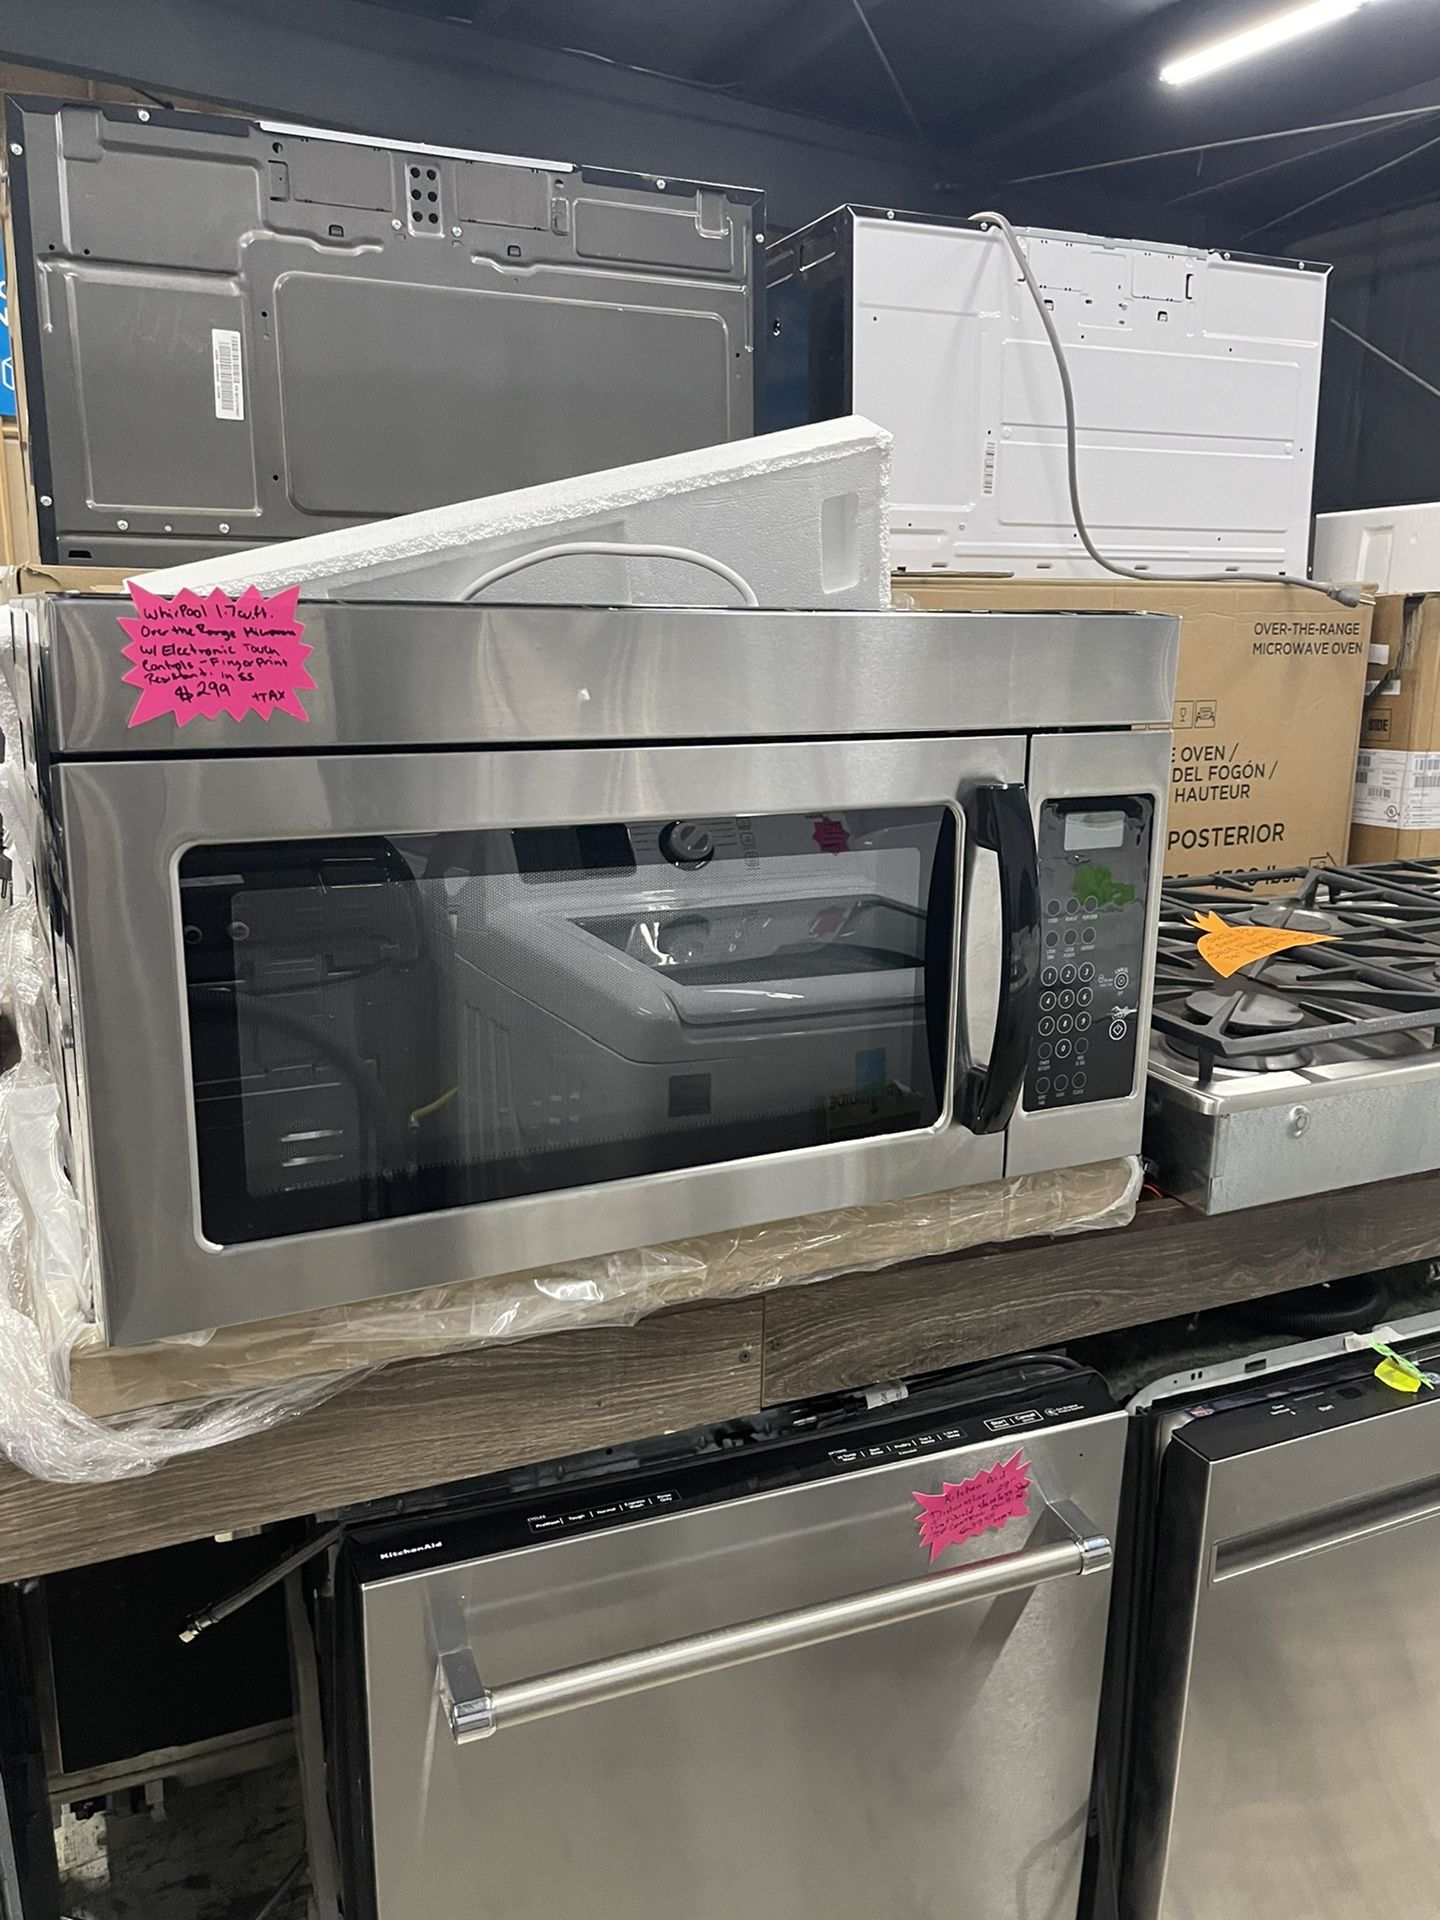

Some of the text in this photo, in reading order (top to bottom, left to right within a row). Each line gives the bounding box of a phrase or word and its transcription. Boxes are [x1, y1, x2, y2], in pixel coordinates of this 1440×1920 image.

[140, 624, 169, 638] Over
[172, 625, 196, 637] the
[196, 624, 236, 642] Range
[1253, 622, 1360, 636] OVER-THE-RANGE
[162, 643, 236, 656] Electronic
[1252, 641, 1363, 656] MICROWAVE OVEN
[174, 681, 232, 703] $299
[1180, 744, 1226, 764] OVEN
[1172, 767, 1203, 784] DEL
[1208, 760, 1266, 782] FOGÓN
[1174, 784, 1251, 804] HAUTEUR
[1168, 822, 1286, 851] POSTERIOR
[379, 1540, 444, 1561] KitchenAid
